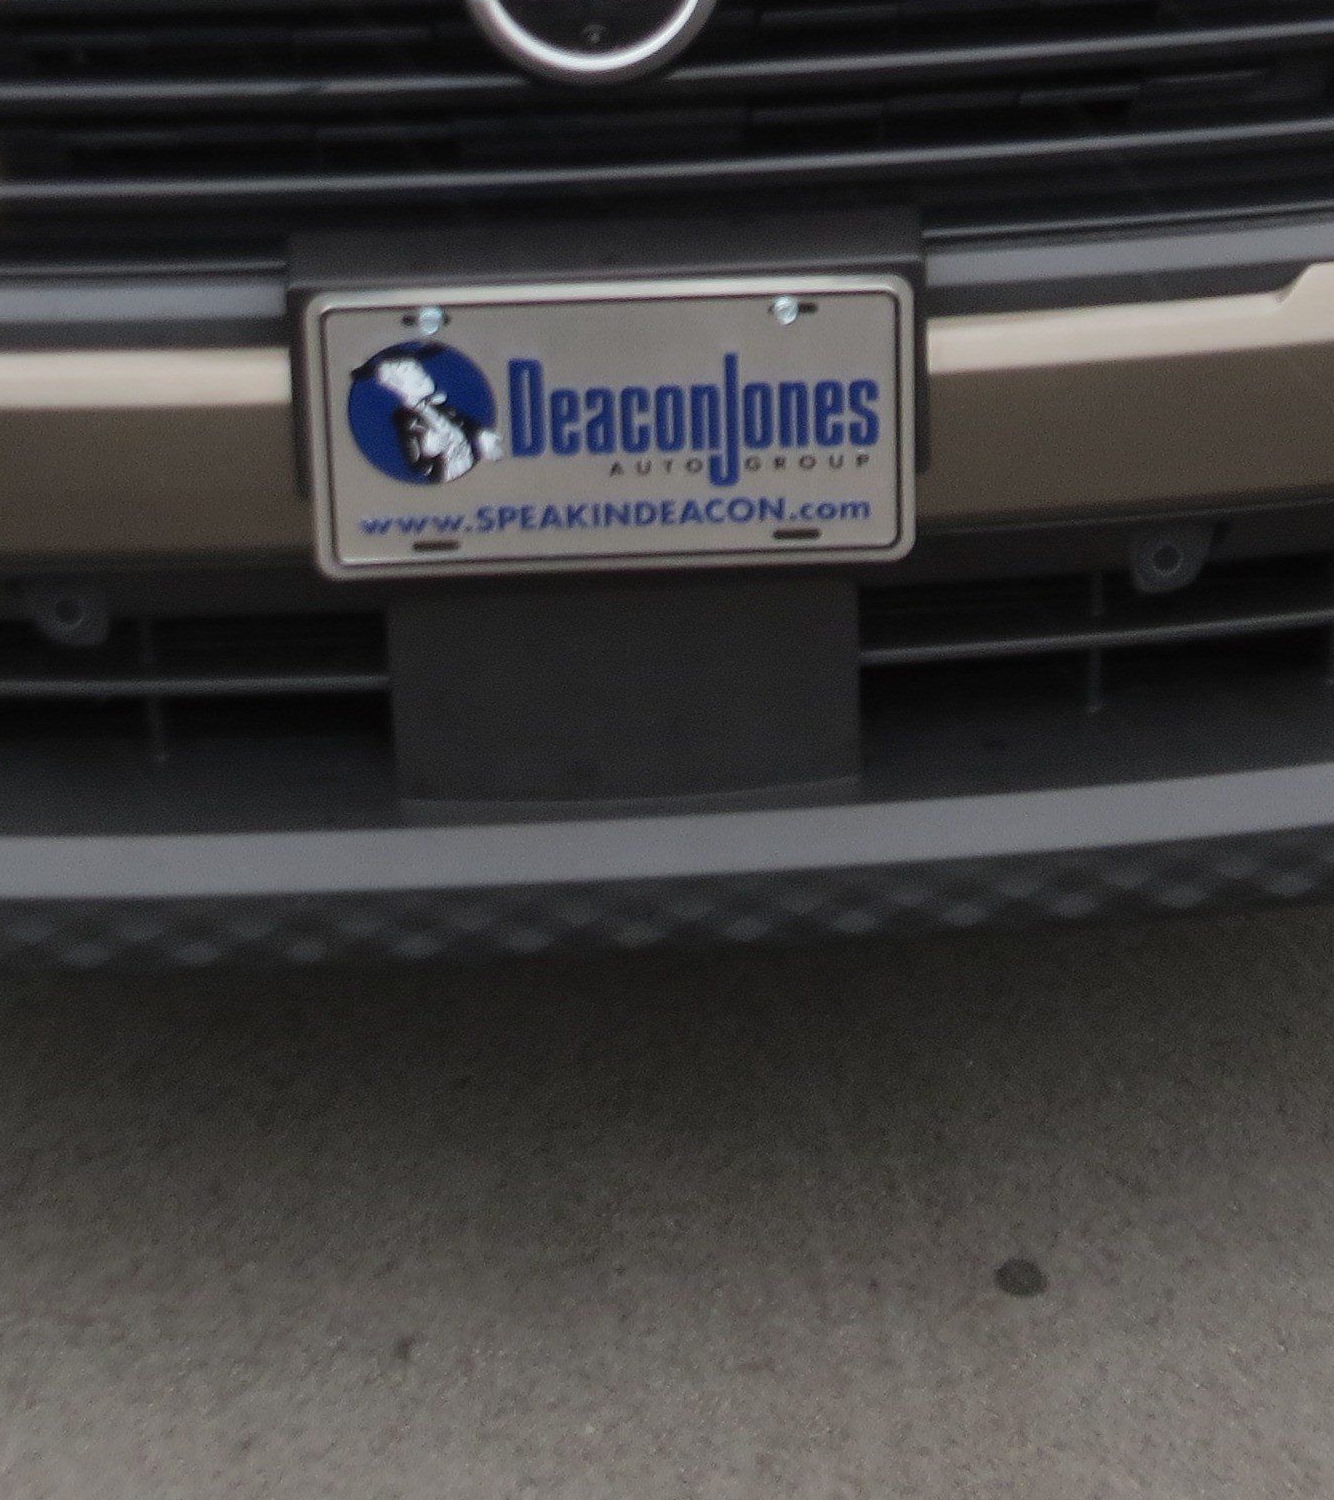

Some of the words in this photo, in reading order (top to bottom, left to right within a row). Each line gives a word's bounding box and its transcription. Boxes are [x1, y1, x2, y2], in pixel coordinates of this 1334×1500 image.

[609, 457, 703, 478] AUTO
[744, 453, 871, 473] GROUP
[358, 496, 872, 536] www.SPEAKINDEACON.com
